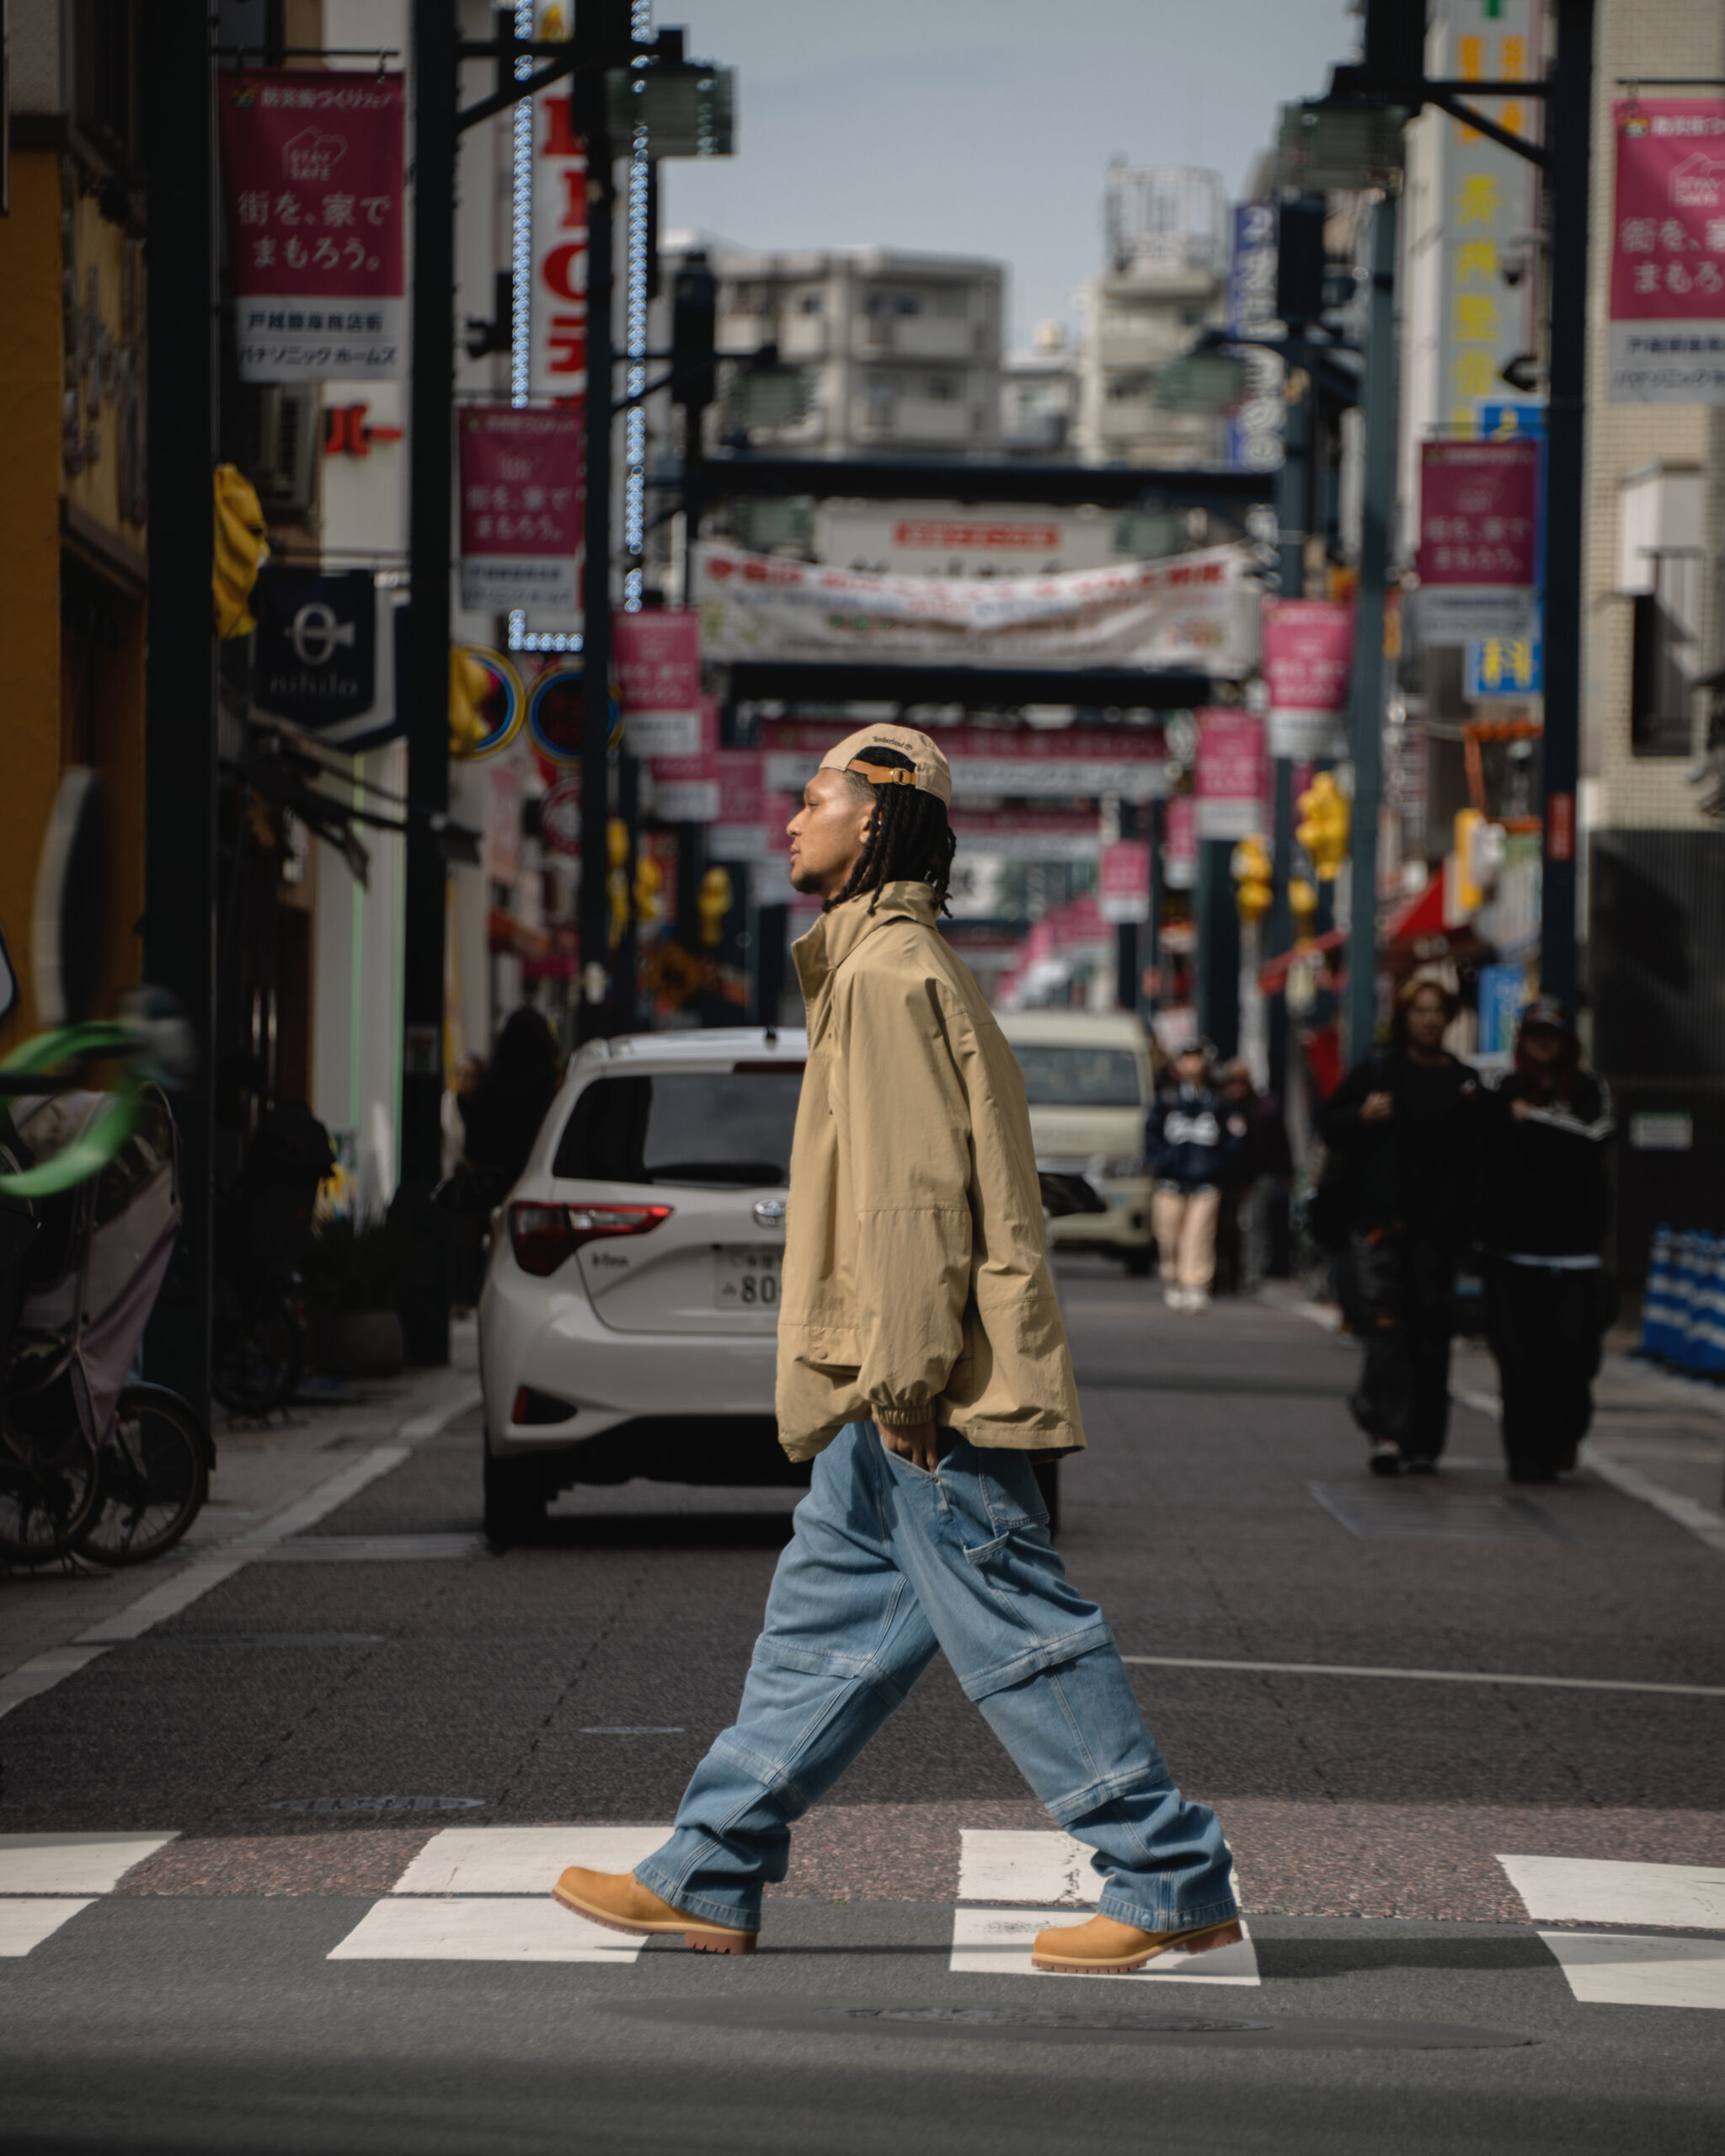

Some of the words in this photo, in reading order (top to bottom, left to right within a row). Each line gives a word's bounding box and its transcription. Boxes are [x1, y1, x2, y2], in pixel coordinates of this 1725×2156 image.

[290, 148, 332, 164] STAY
[290, 164, 331, 181] SAFE
[238, 190, 393, 227] 街を、家で
[254, 235, 381, 271] まもろう。
[248, 310, 384, 333] 戸越銀座商店街
[270, 673, 359, 699] nihilo
[873, 736, 905, 748] Timberland
